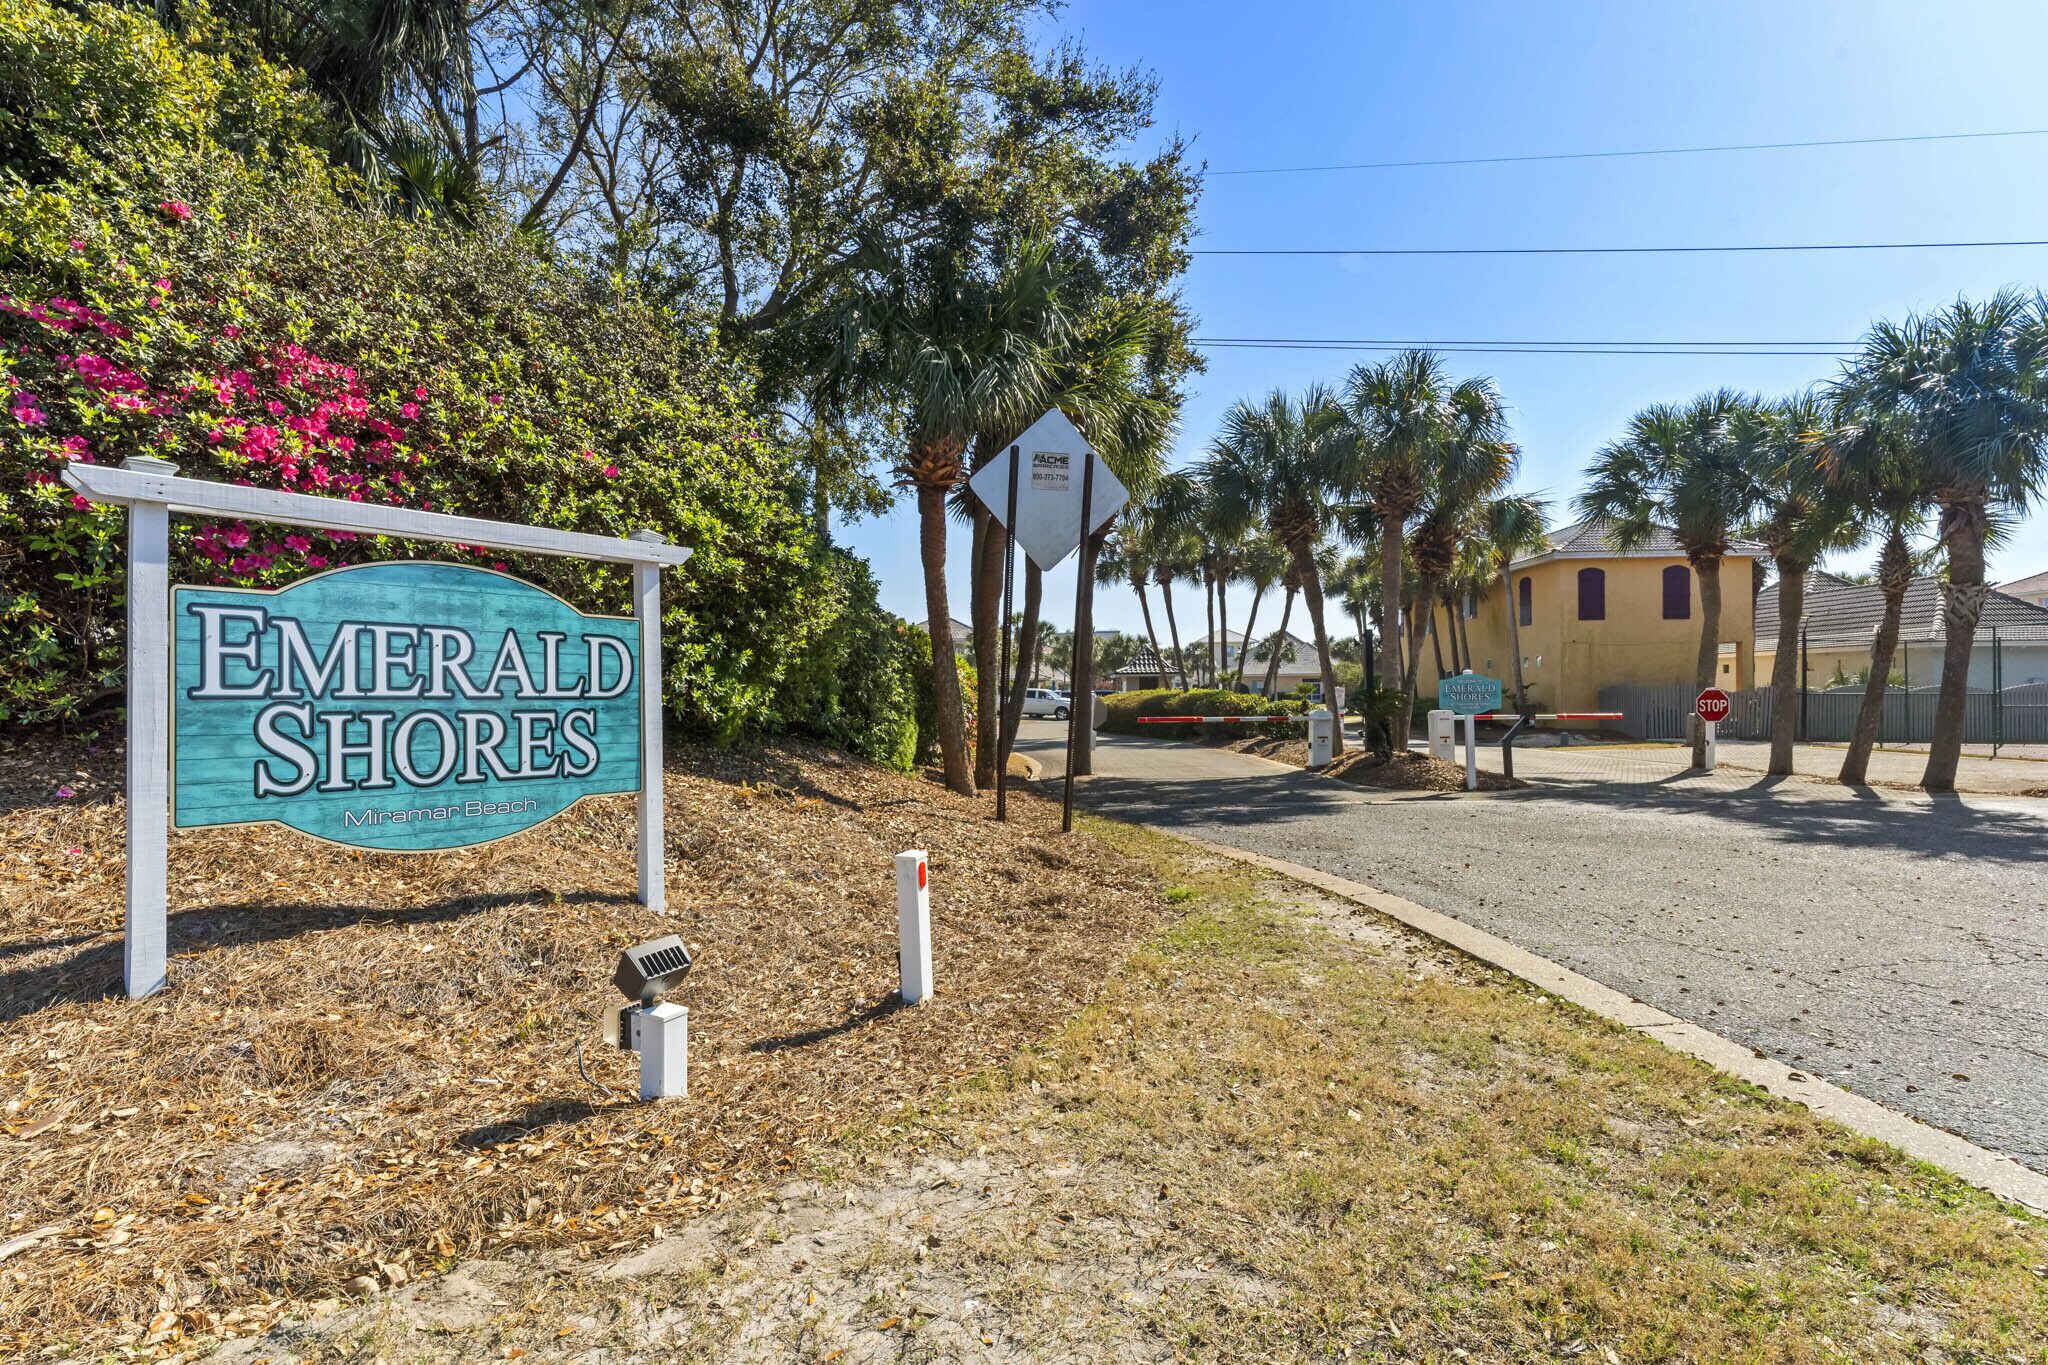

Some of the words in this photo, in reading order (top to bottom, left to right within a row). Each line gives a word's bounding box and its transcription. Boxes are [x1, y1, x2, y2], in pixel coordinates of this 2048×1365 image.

[1039, 454, 1069, 464] ACME
[187, 602, 634, 700] EMERALD
[1445, 684, 1496, 693] EMERALD
[1449, 693, 1490, 701] SHORES
[1699, 699, 1728, 712] STOP
[254, 700, 601, 798] SHORES
[344, 808, 460, 828] Miramar
[464, 797, 538, 818] Beach
